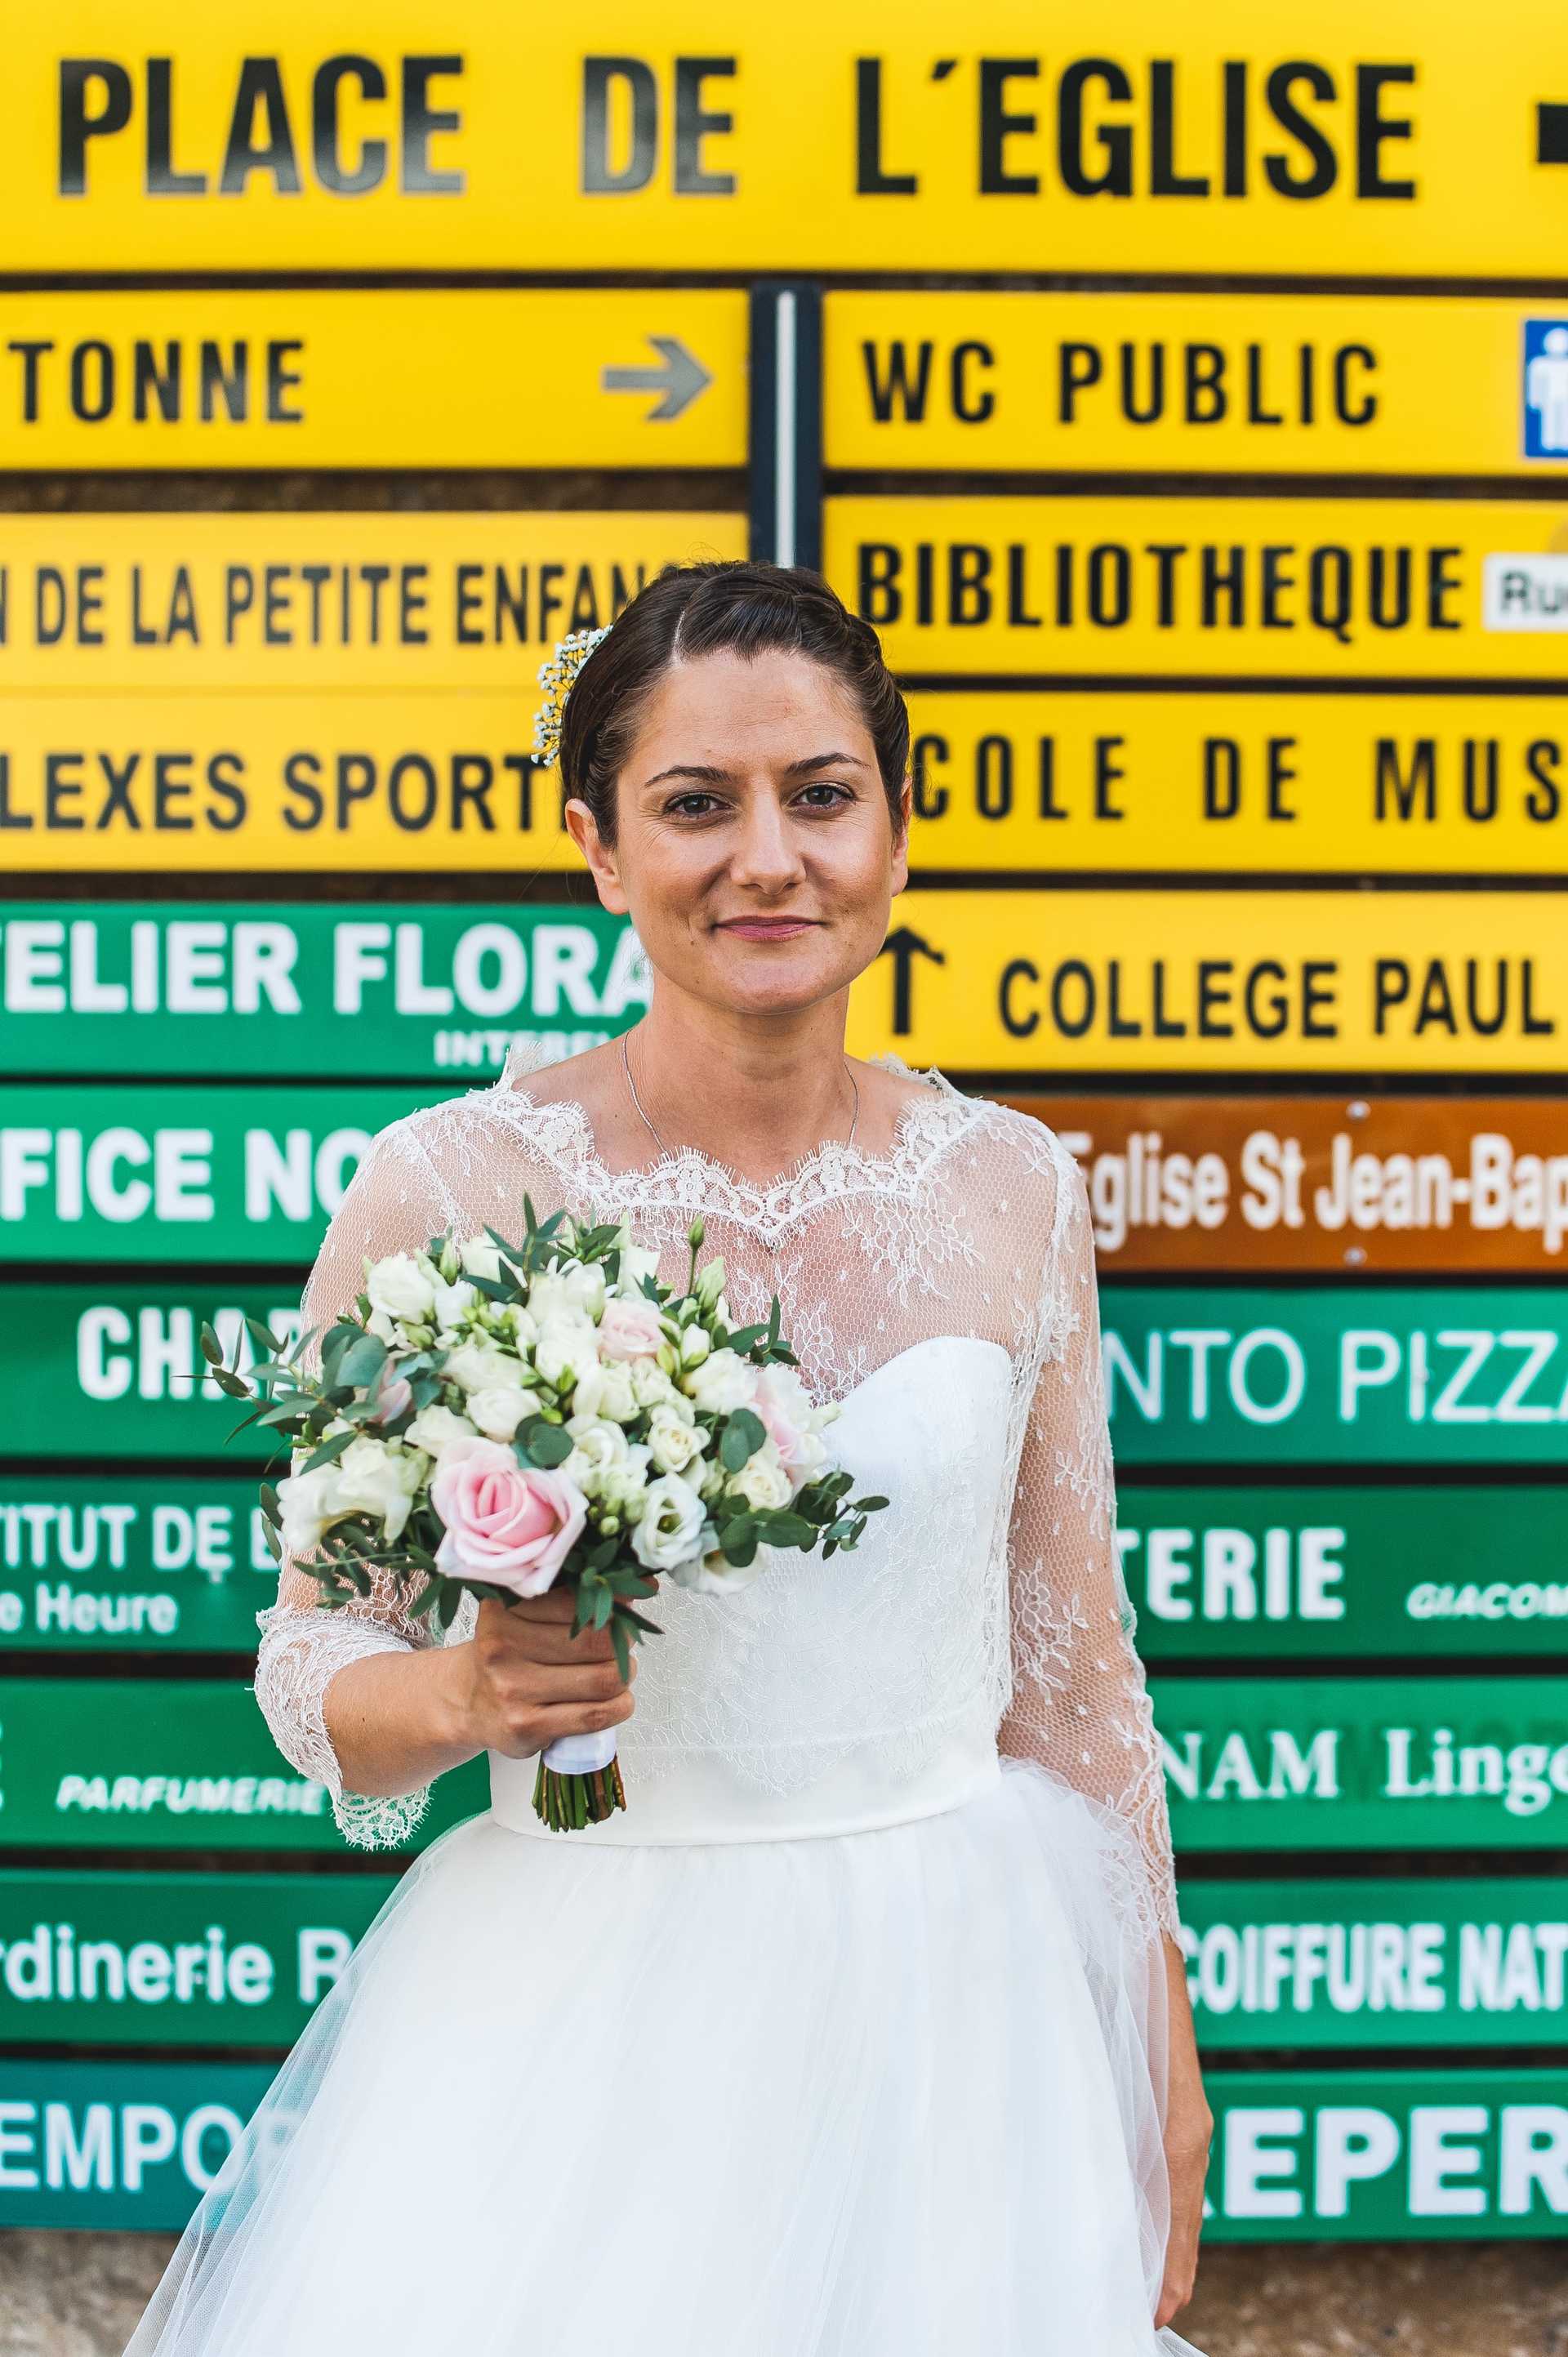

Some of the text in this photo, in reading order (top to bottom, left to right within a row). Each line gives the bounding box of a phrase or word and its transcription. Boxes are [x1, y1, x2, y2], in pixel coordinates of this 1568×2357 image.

[57, 54, 464, 196] PLACE
[581, 56, 737, 196] DE
[7, 340, 305, 423] TONNE
[862, 340, 1379, 425] WC PUBLIC
[35, 565, 105, 645] DE
[131, 564, 199, 645] LA
[225, 564, 429, 644] PETITE
[457, 564, 660, 644] ENFAN
[858, 542, 1463, 644] BIBLIOTHEQUE
[1501, 570, 1568, 614] Ru
[0, 753, 572, 831] LEXES SPORT
[1205, 738, 1297, 820] DE
[1375, 739, 1561, 822] MUS
[0, 920, 302, 1014] ELIER
[997, 959, 1554, 1038] COLLEGE PAUL
[0, 1127, 214, 1222] FICE
[1241, 1131, 1306, 1231] St
[1101, 1328, 1568, 1424] NTO PIZZ
[0, 1504, 136, 1569] ITUT
[153, 1505, 234, 1571] DE
[37, 1583, 178, 1633] Heure
[56, 1776, 328, 1816] PARFUMERIE
[0, 1924, 272, 2004] dinerie
[1202, 2105, 1568, 2218] EPER
